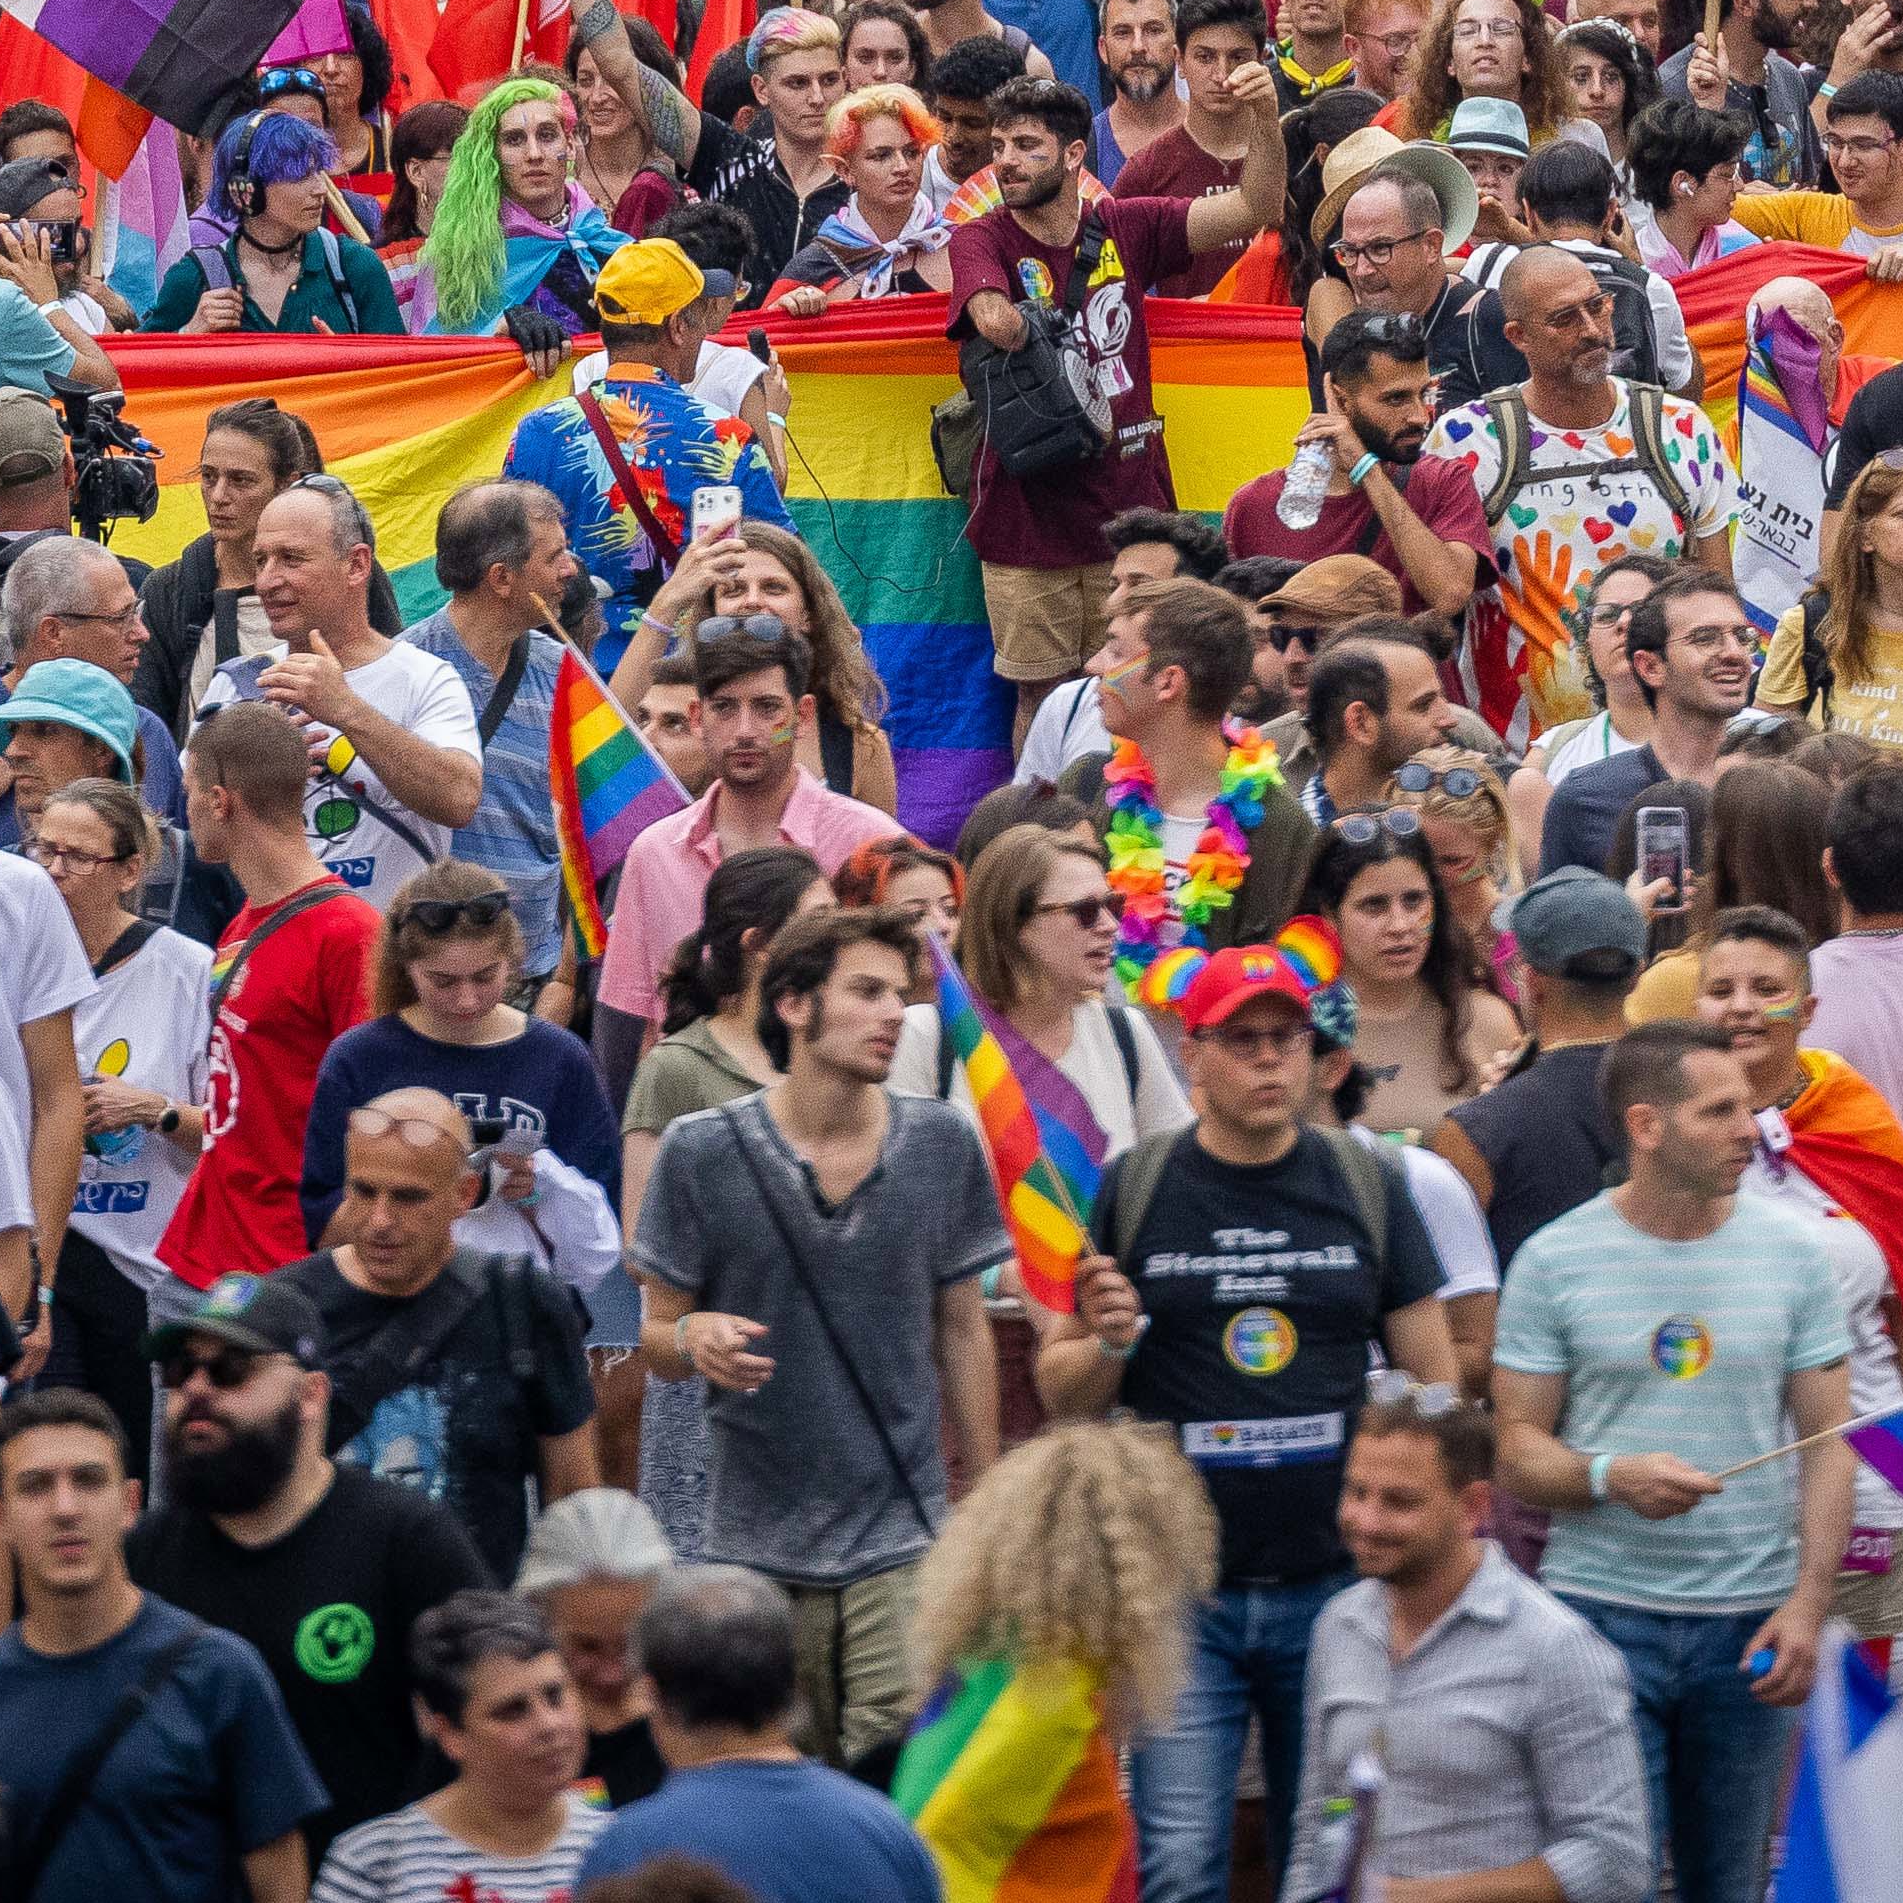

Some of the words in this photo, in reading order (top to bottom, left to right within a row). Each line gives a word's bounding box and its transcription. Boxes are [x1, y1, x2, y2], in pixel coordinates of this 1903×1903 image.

[1739, 508, 1795, 556] בבאר-ש
[1769, 501, 1815, 541] בית
[1850, 681, 1897, 701] Kind
[1212, 1228, 1290, 1249] The
[1145, 1245, 1359, 1276] Stonewall
